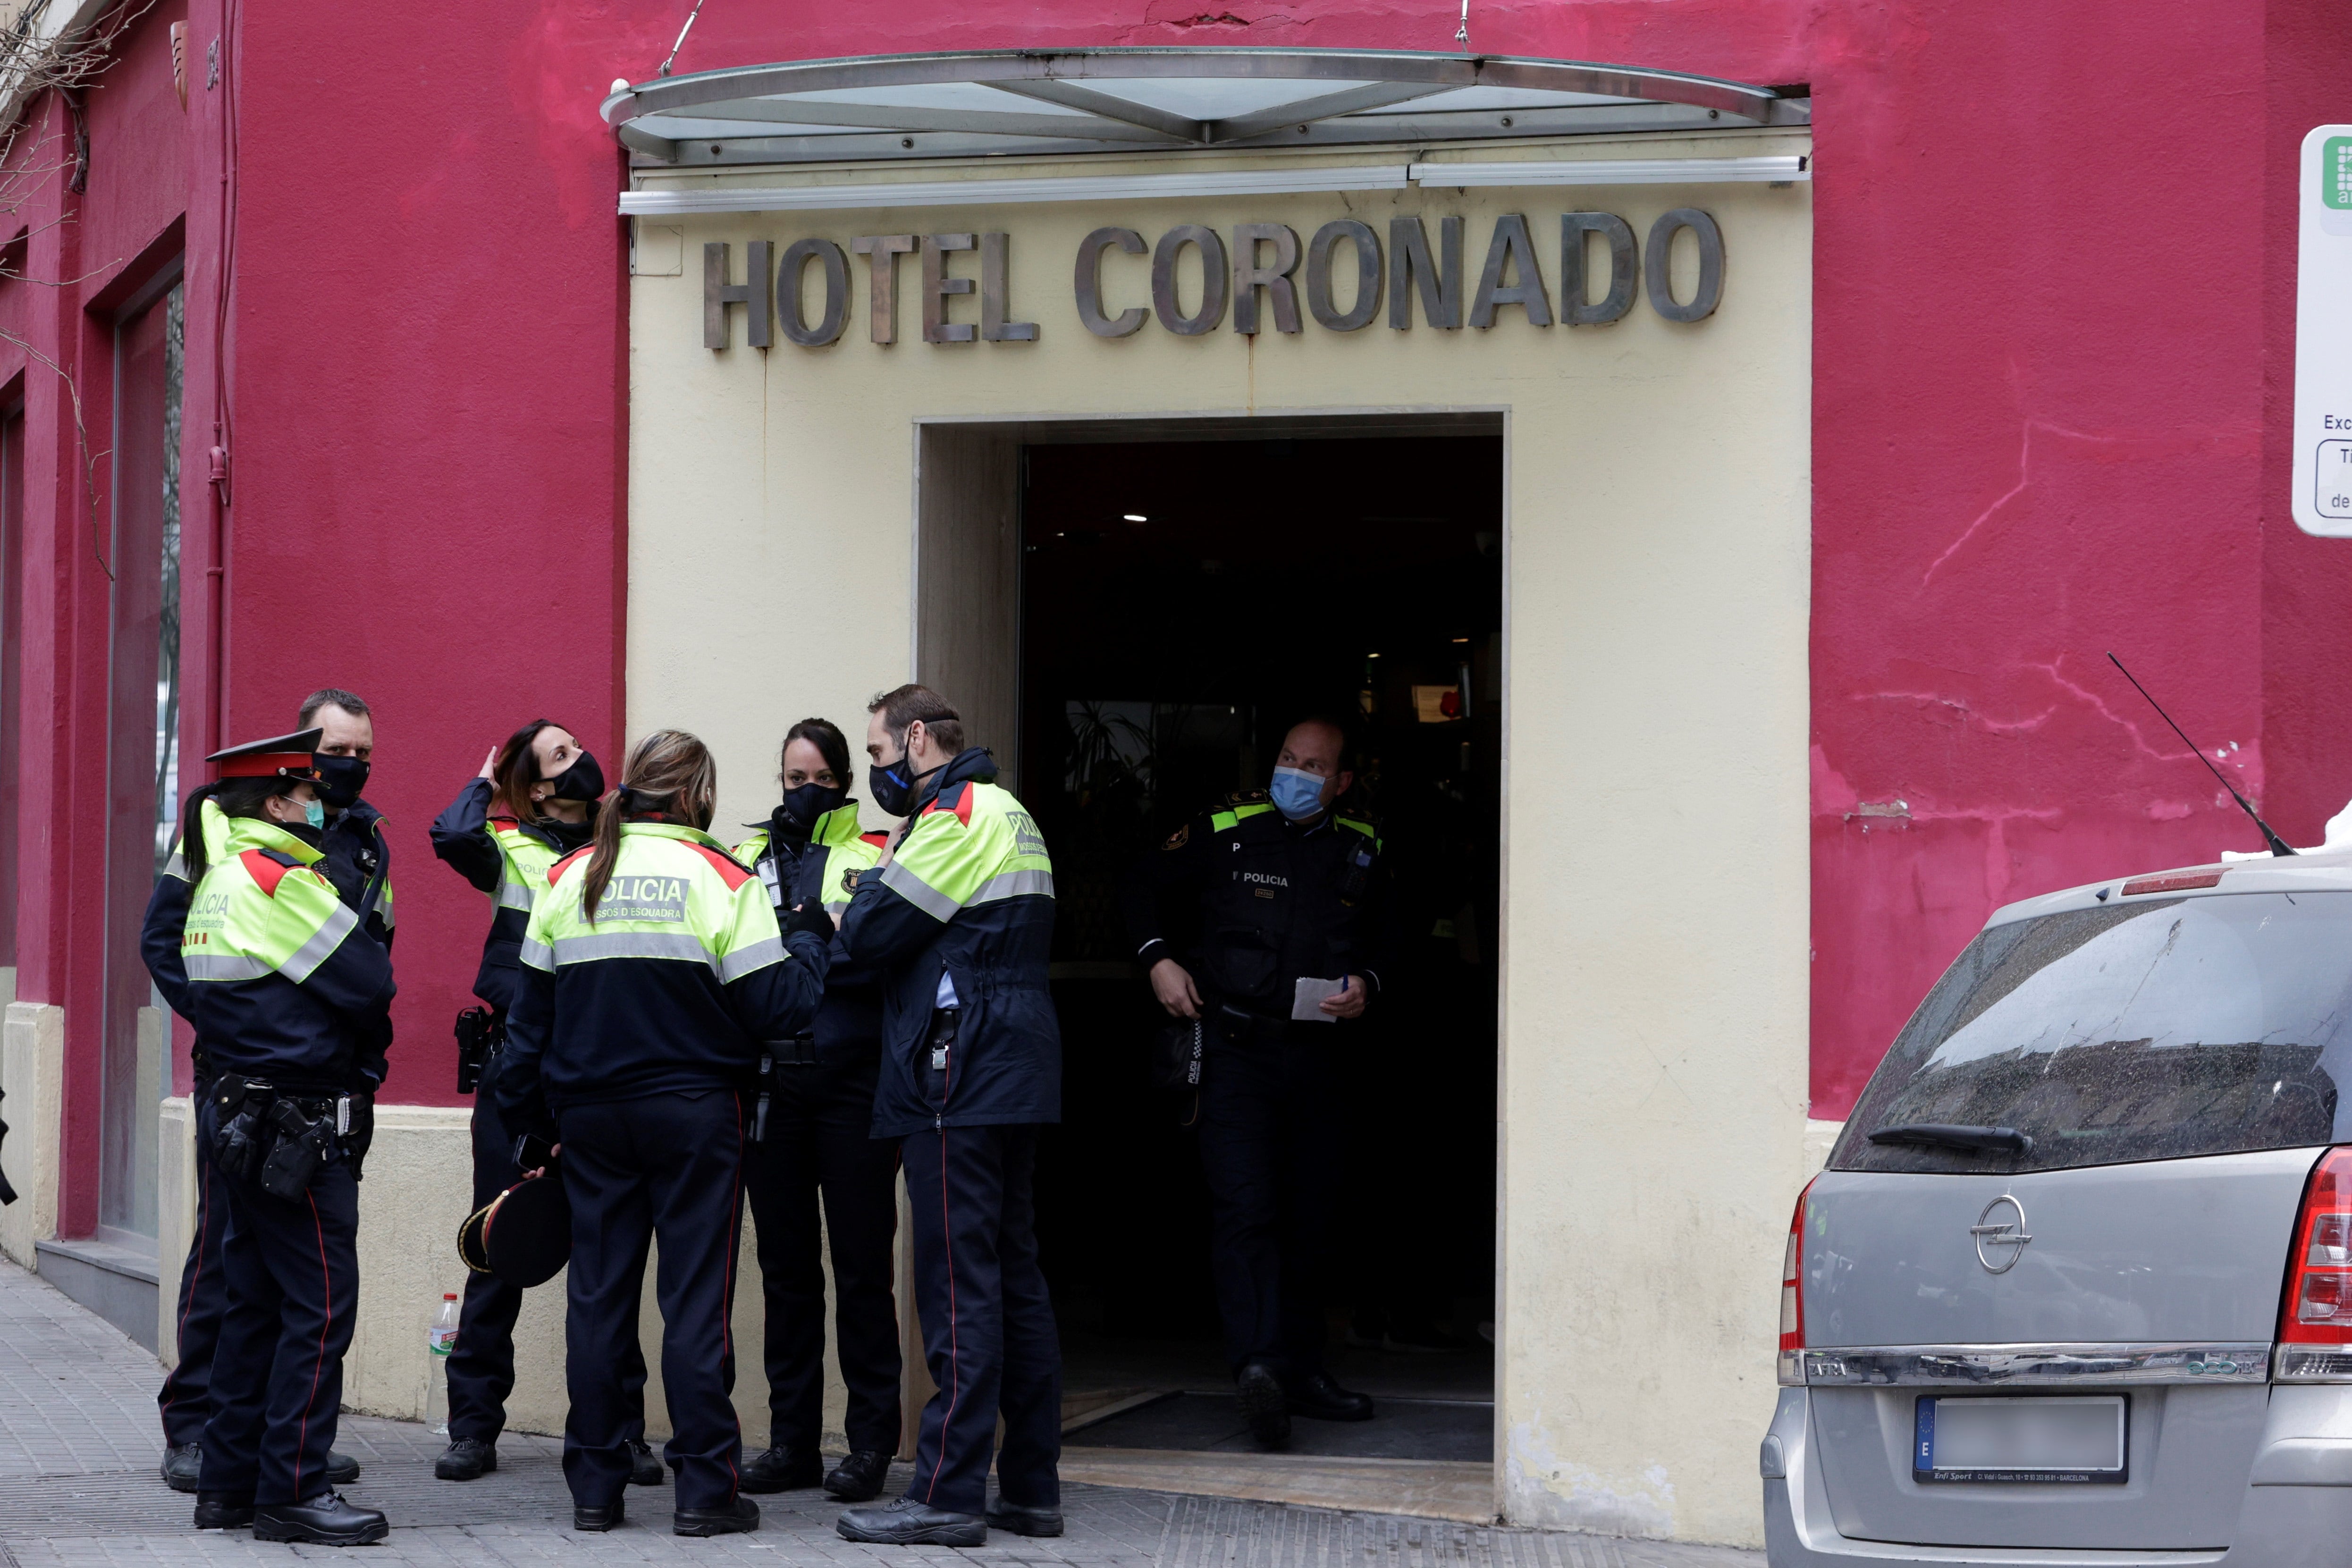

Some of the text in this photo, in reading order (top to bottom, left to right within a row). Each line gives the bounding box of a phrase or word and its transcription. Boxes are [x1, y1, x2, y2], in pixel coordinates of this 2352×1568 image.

[703, 208, 1726, 350] HOTEL CORONADO
[2332, 493, 2350, 508] de
[1244, 872, 1288, 887] POLICIA
[581, 878, 683, 904] OLICIA
[189, 894, 228, 916] OLICIA
[621, 907, 681, 919] D'ESQUADRA
[1188, 1061, 1197, 1084] POLICIA
[1922, 1442, 1929, 1456] E
[1934, 1472, 1949, 1480] Enfi
[1950, 1472, 1972, 1481] Sport
